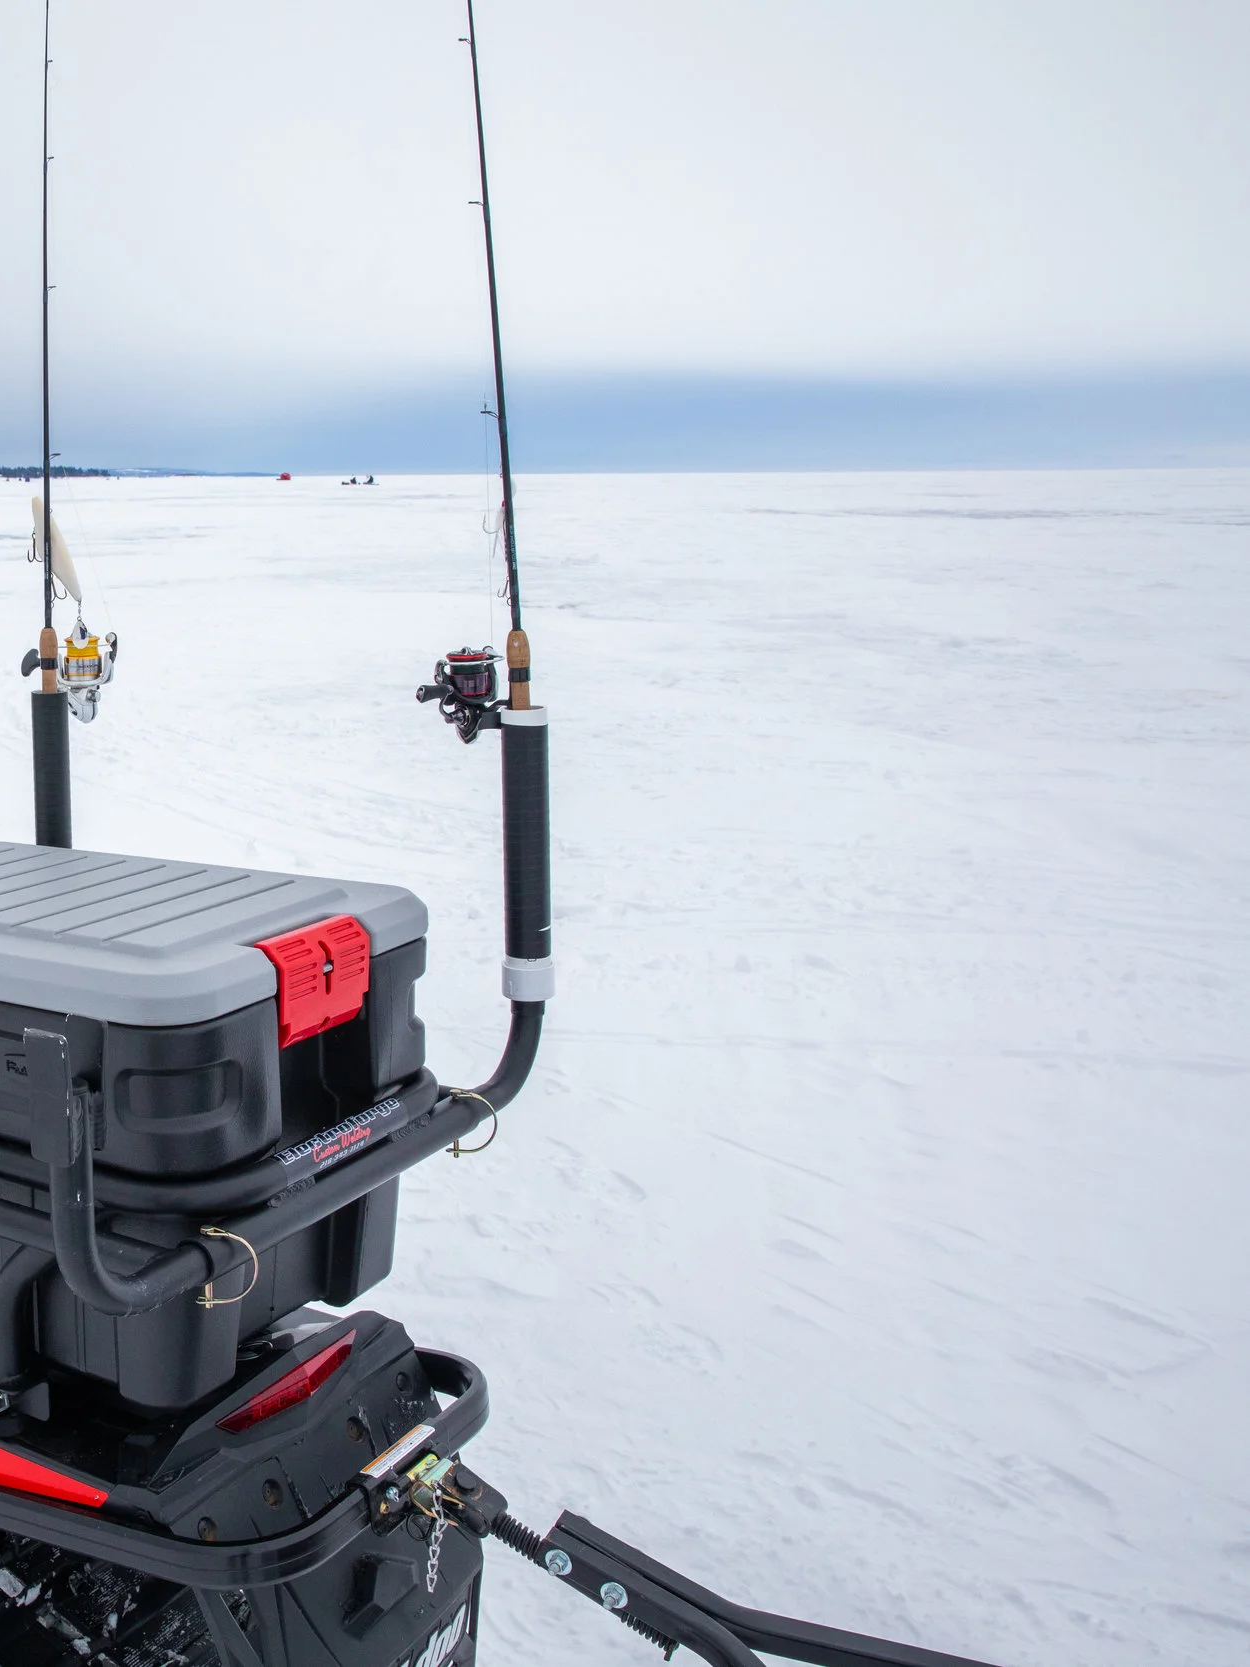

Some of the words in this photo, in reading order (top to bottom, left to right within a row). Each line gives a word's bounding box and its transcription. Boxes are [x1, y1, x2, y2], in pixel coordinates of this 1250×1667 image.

[274, 1097, 400, 1166] Electroforge
[312, 1143, 341, 1163] Custom
[337, 1125, 372, 1148] Welding
